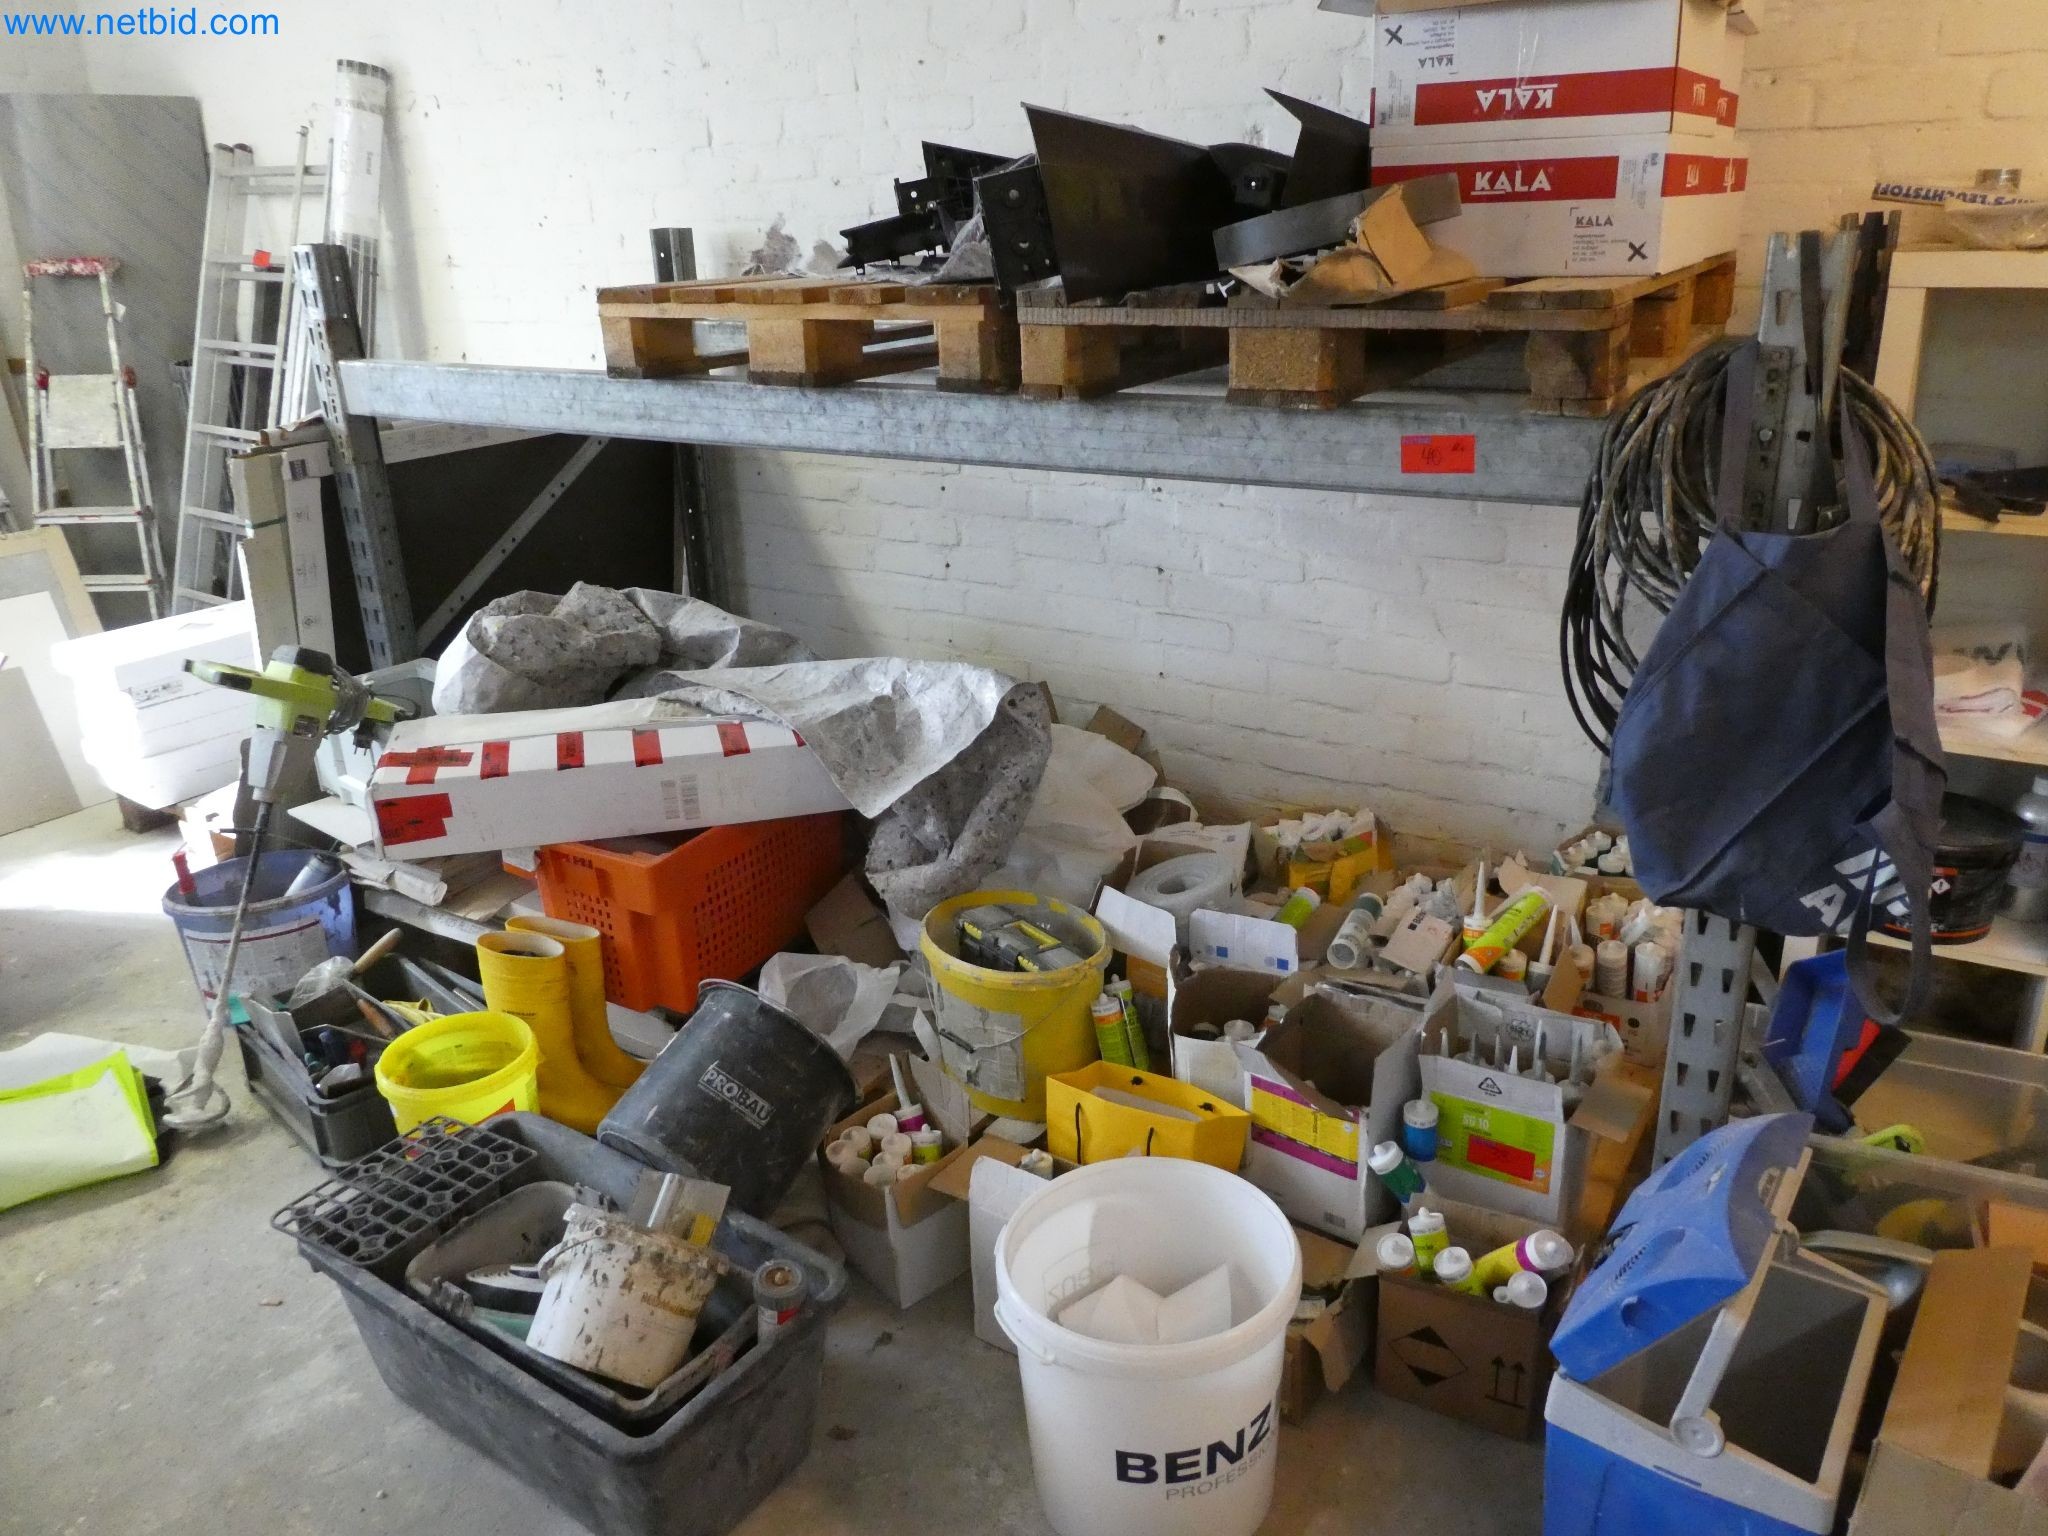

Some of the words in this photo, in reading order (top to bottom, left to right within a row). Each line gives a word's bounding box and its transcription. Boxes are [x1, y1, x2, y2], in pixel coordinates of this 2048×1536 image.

[1418, 54, 1454, 69] KALA
[1475, 86, 1554, 113] KALA
[1474, 167, 1552, 193] KALA
[1575, 214, 1614, 228] KALA
[1115, 1400, 1272, 1485] BENZ
